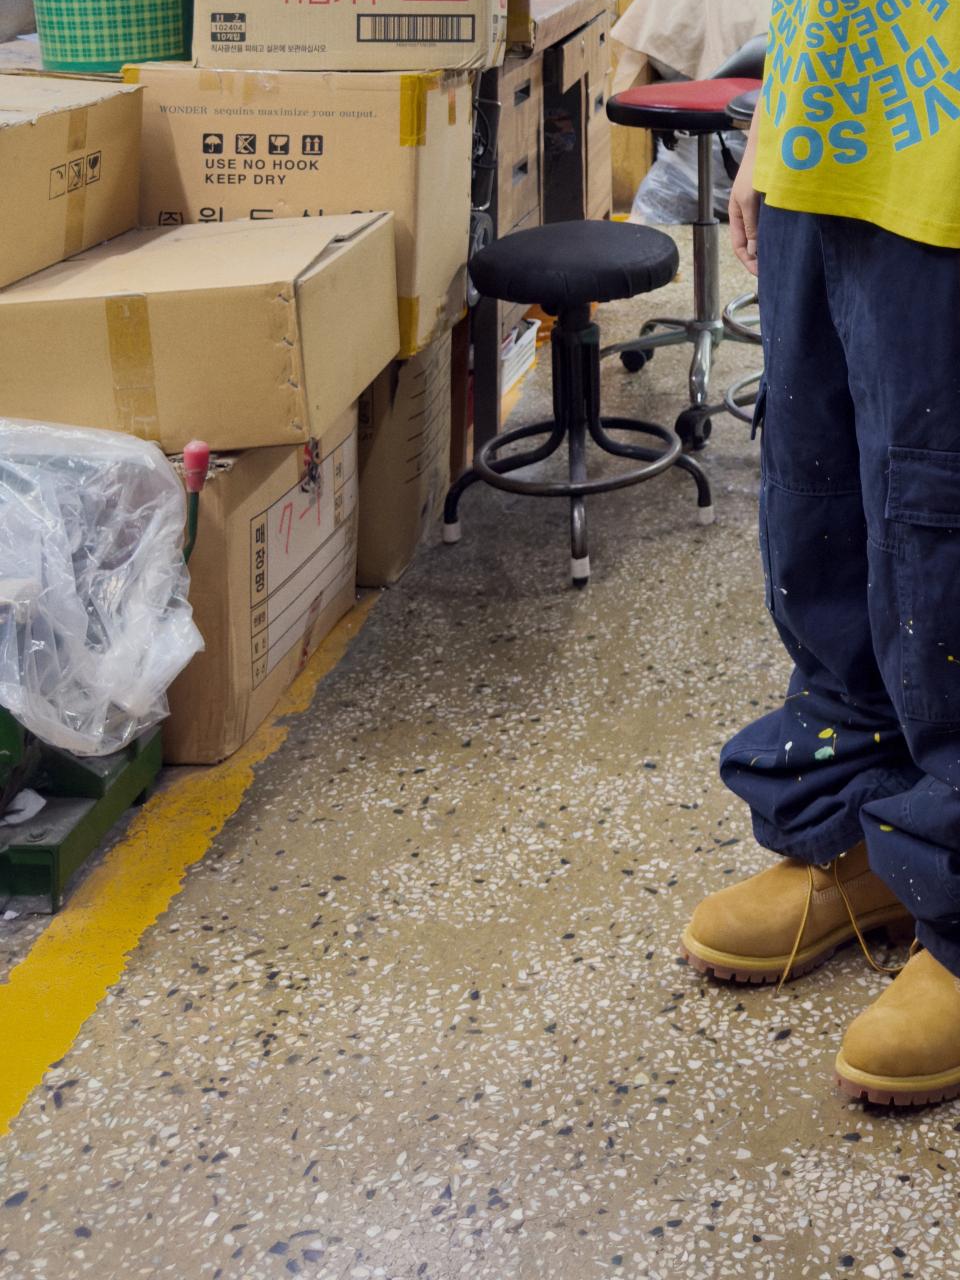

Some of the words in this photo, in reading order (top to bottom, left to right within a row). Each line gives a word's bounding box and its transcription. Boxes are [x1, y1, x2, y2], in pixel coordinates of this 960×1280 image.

[802, 36, 950, 122] IDEAS
[159, 104, 208, 115] WONDER
[213, 106, 254, 117] sequins
[258, 106, 310, 117] maximize
[312, 109, 335, 119] your
[781, 120, 867, 170] SO
[205, 158, 236, 170] USE
[243, 159, 266, 170] NO
[272, 160, 319, 171] HOOK
[205, 173, 247, 185] KEEP
[253, 174, 286, 185] DRY
